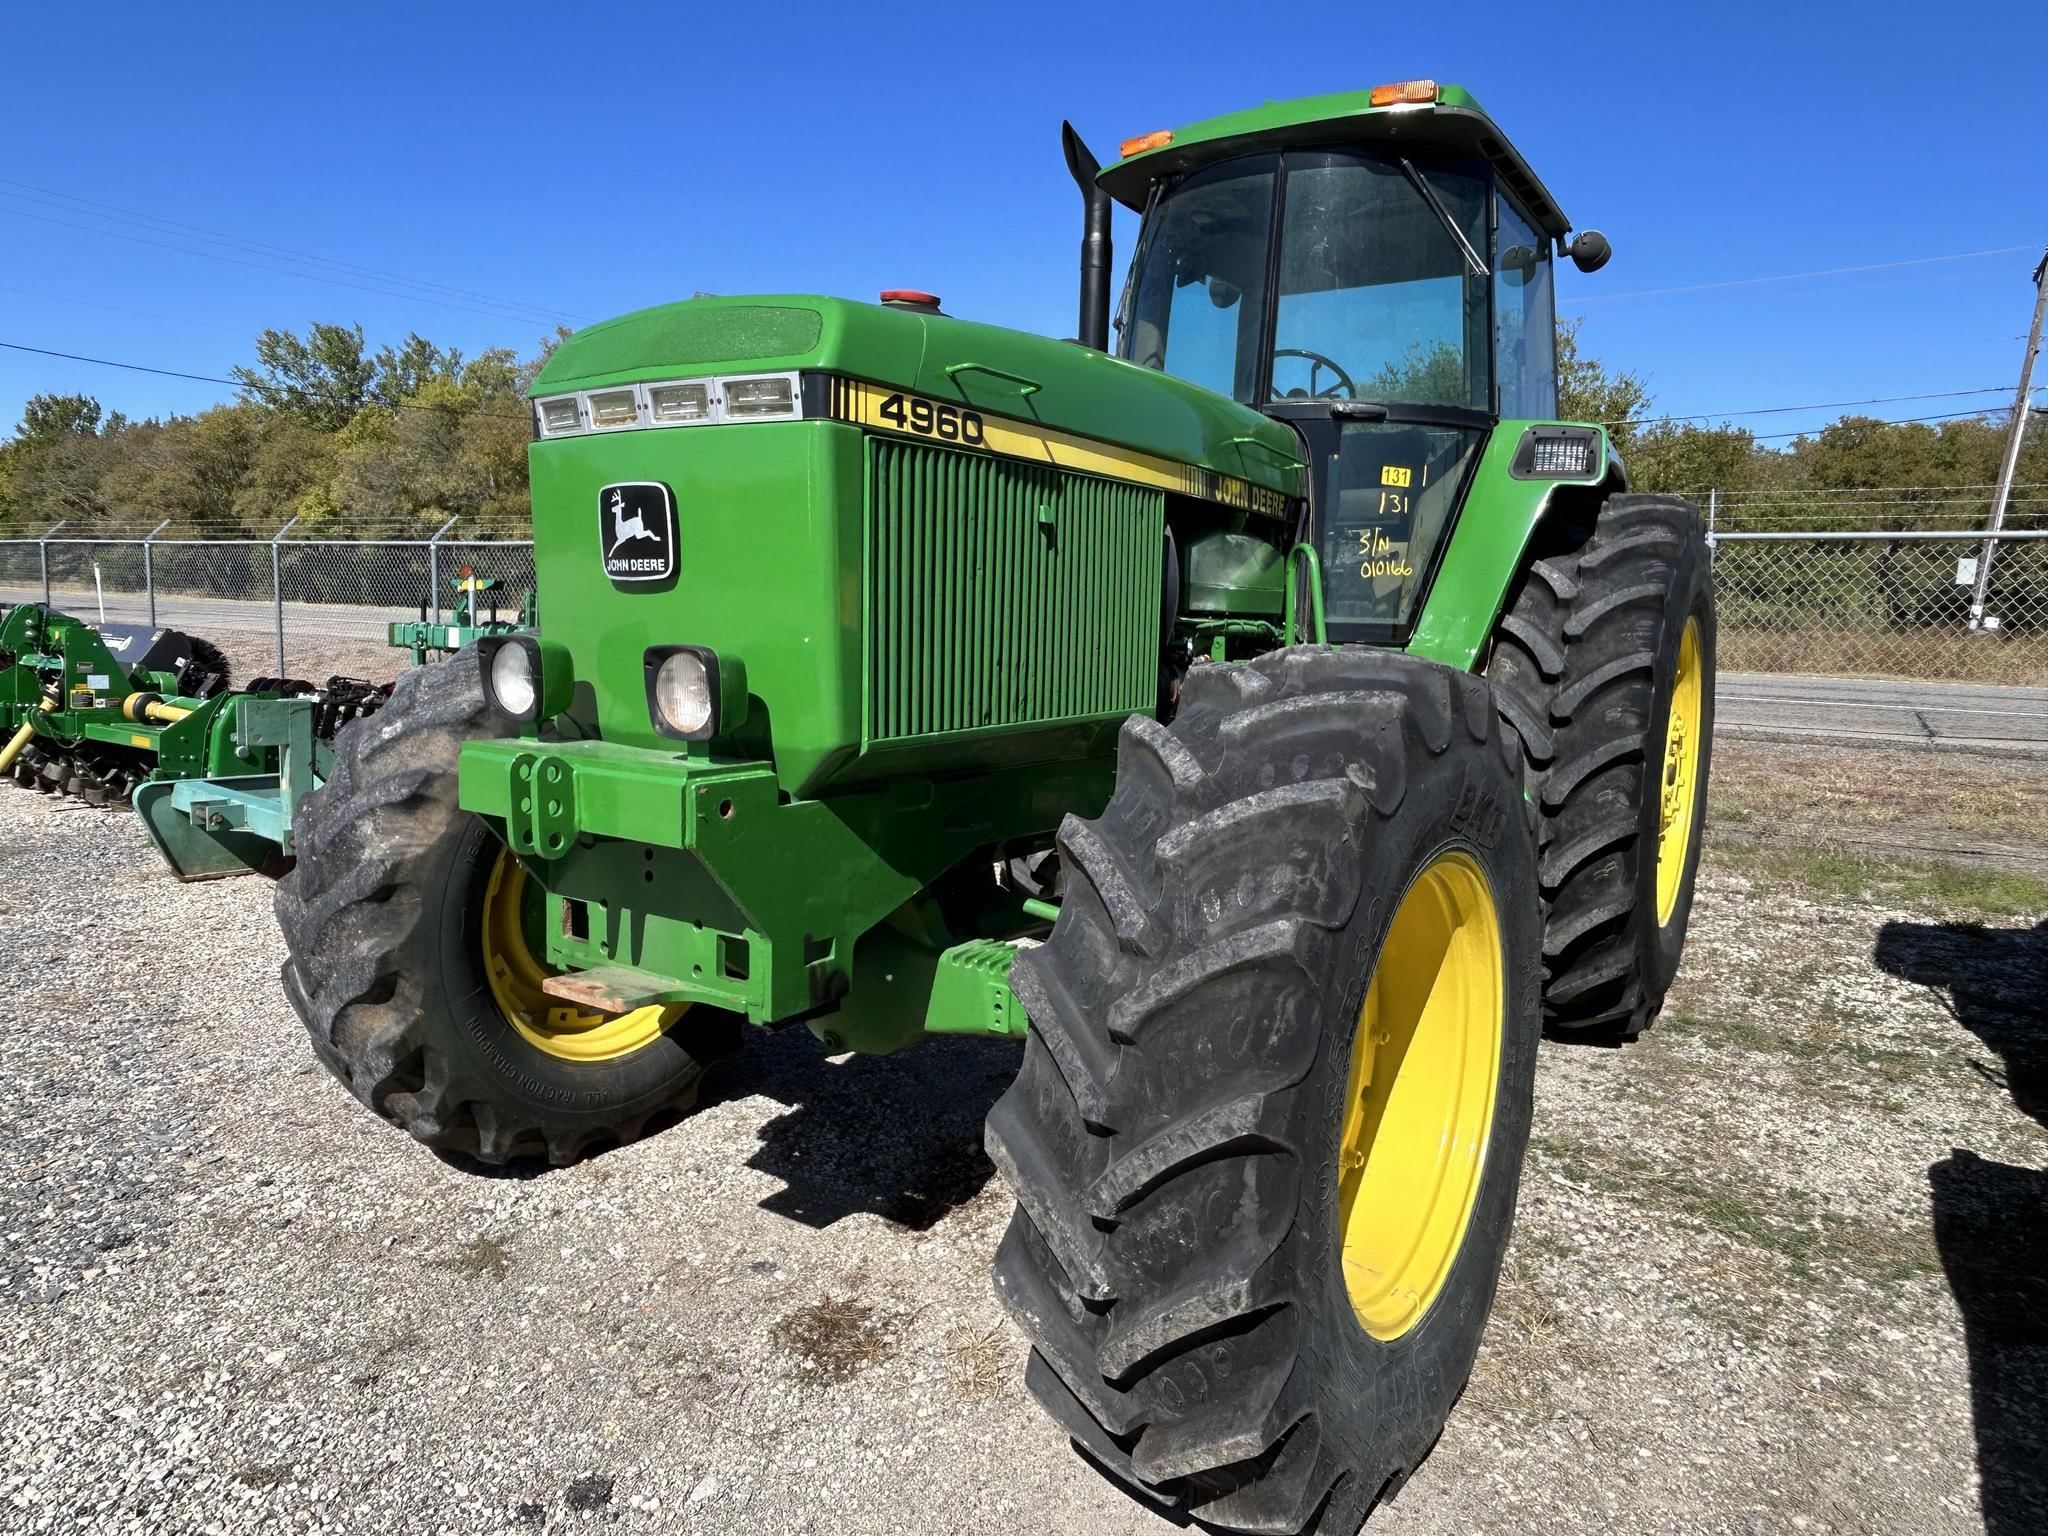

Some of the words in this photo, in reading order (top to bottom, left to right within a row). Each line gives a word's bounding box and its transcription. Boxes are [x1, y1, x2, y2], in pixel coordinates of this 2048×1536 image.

[880, 393, 983, 445] 4960
[1384, 468, 1408, 485] 131
[1215, 475, 1249, 508] JOHN
[1252, 486, 1285, 517] DEERE
[1379, 491, 1408, 514] 131
[607, 559, 629, 571] JOHN
[630, 559, 665, 571] DEERE
[1360, 559, 1413, 578] 010166
[466, 1015, 517, 1078] CHAMPION
[517, 1073, 577, 1104] TRACTION
[586, 1090, 609, 1104] ALL
